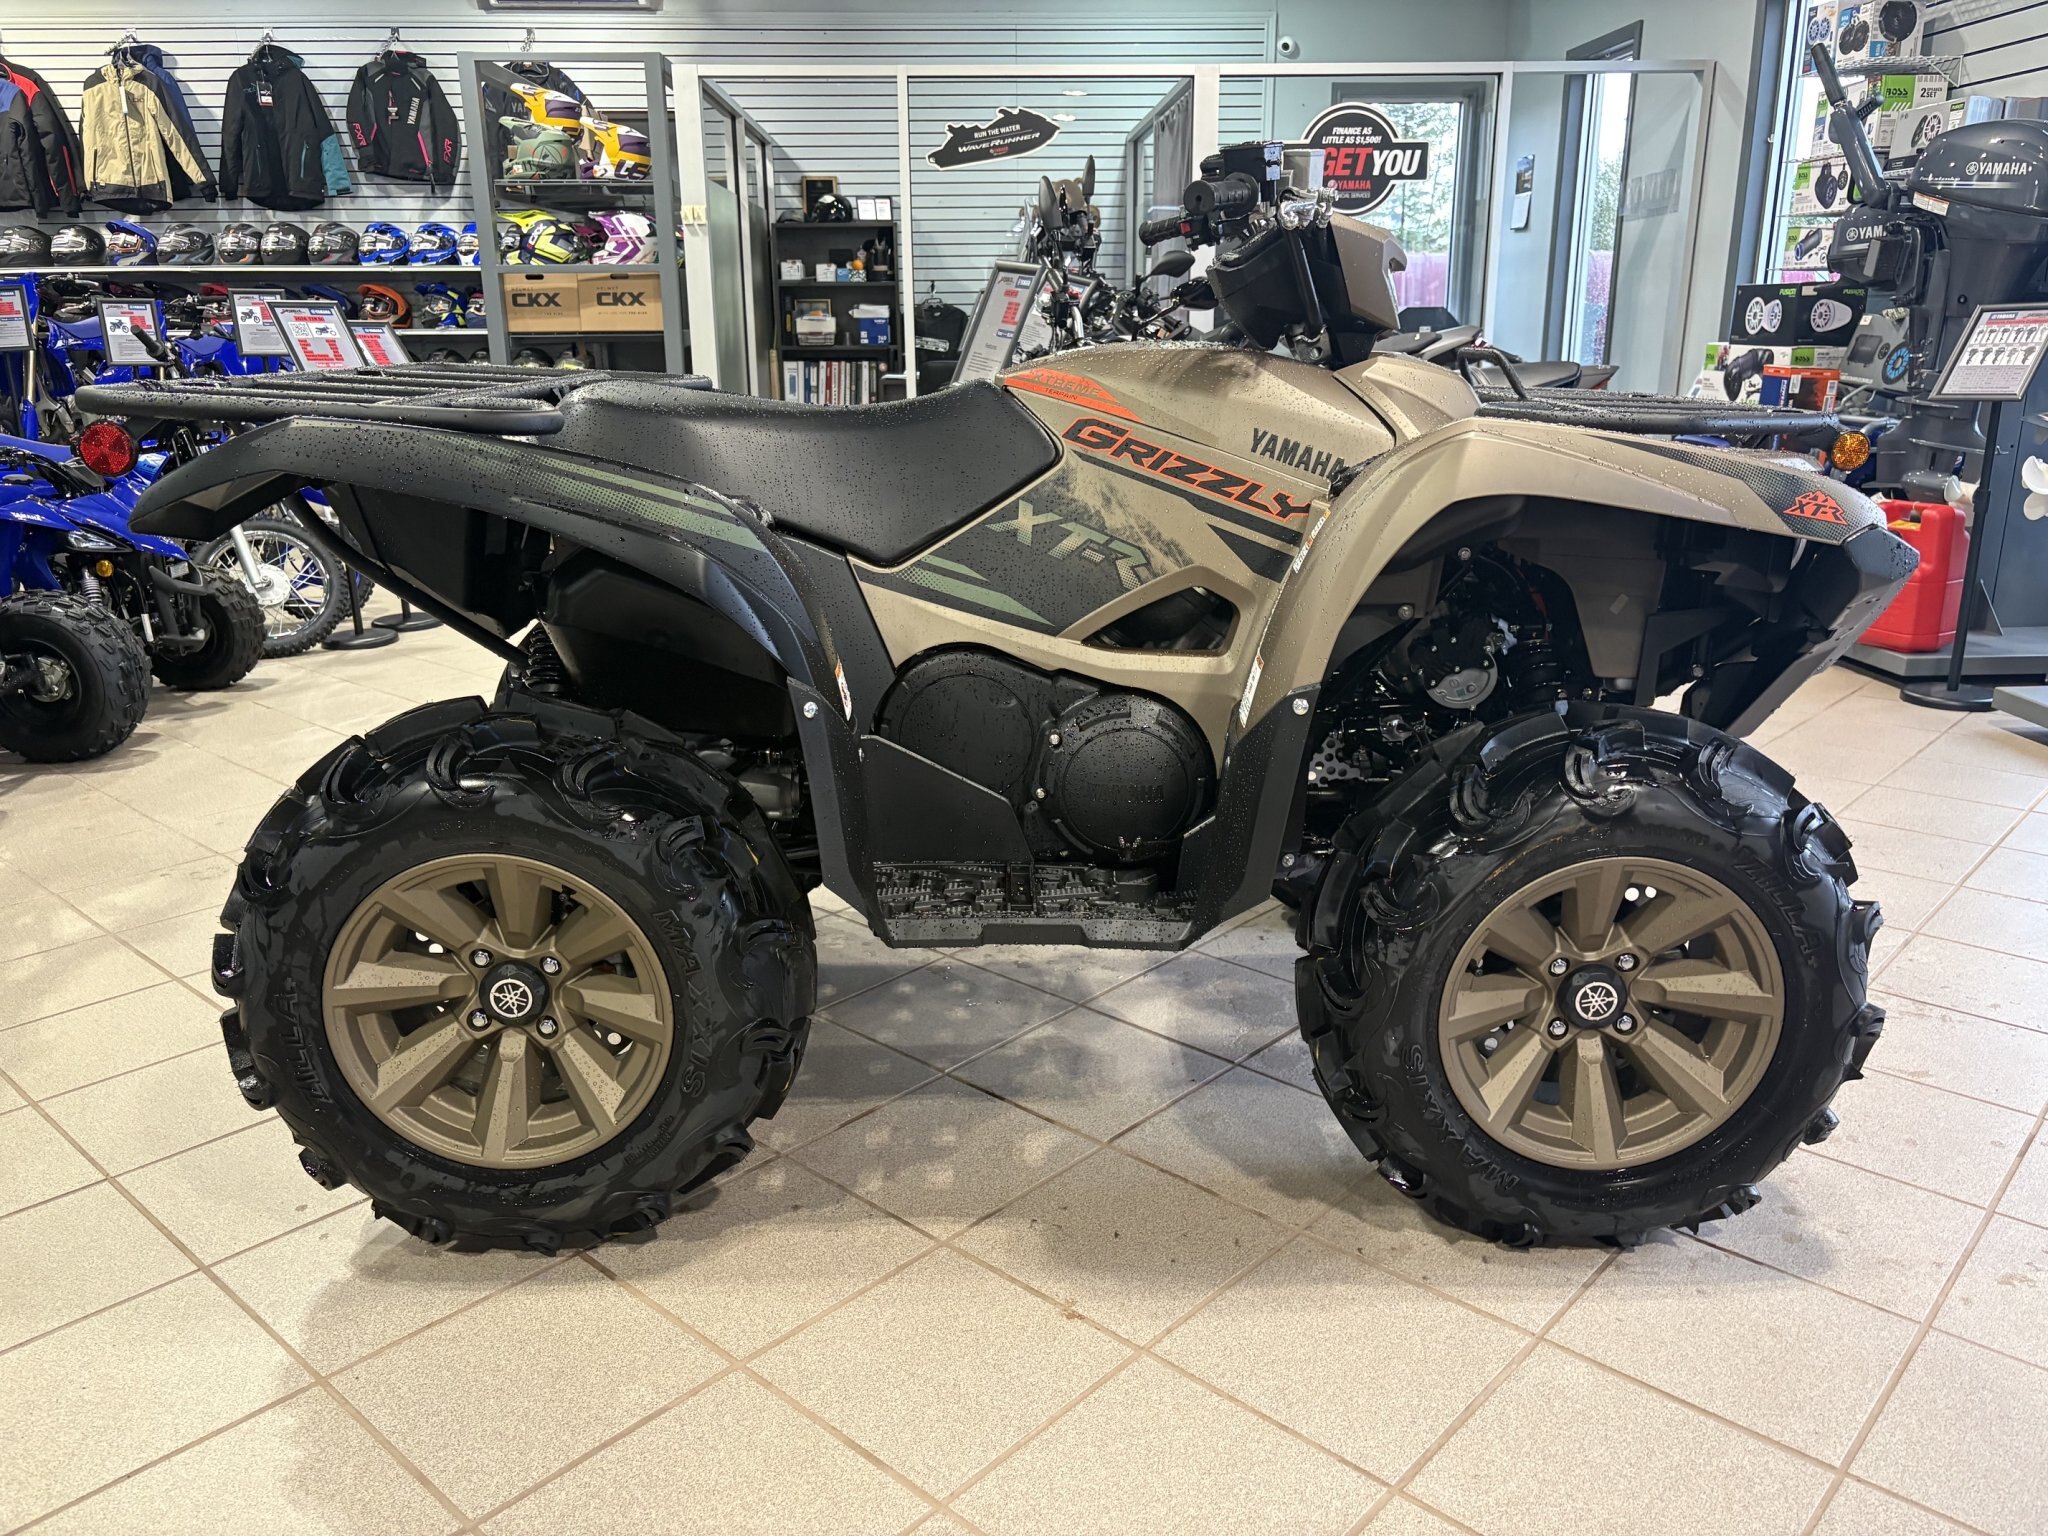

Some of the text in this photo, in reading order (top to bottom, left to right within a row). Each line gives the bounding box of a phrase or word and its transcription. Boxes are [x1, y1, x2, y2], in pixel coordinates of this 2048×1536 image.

[1920, 88, 1927, 98] 2
[407, 97, 420, 125] YAMAHA
[353, 123, 367, 146] FXR
[974, 124, 1021, 139] RUN THE WATER
[1322, 136, 1382, 145] LITTLE AS $1,500!
[1332, 127, 1373, 135] FINANCE AS
[1323, 147, 1422, 177] GET YOU
[1978, 162, 2028, 175] YAMAHA
[1338, 180, 1371, 190] YAMAHA
[529, 222, 547, 245] CKX
[511, 292, 562, 308] CKX
[596, 292, 646, 307] CKX
[1032, 372, 1100, 396] XTREME
[1044, 388, 1078, 400] TERRAIN
[1250, 427, 1346, 480] YAMAHA
[1061, 417, 1312, 522] GRIZZLY
[653, 908, 713, 1098] MAXXIS
[1402, 1044, 1521, 1190] MAXXIS
